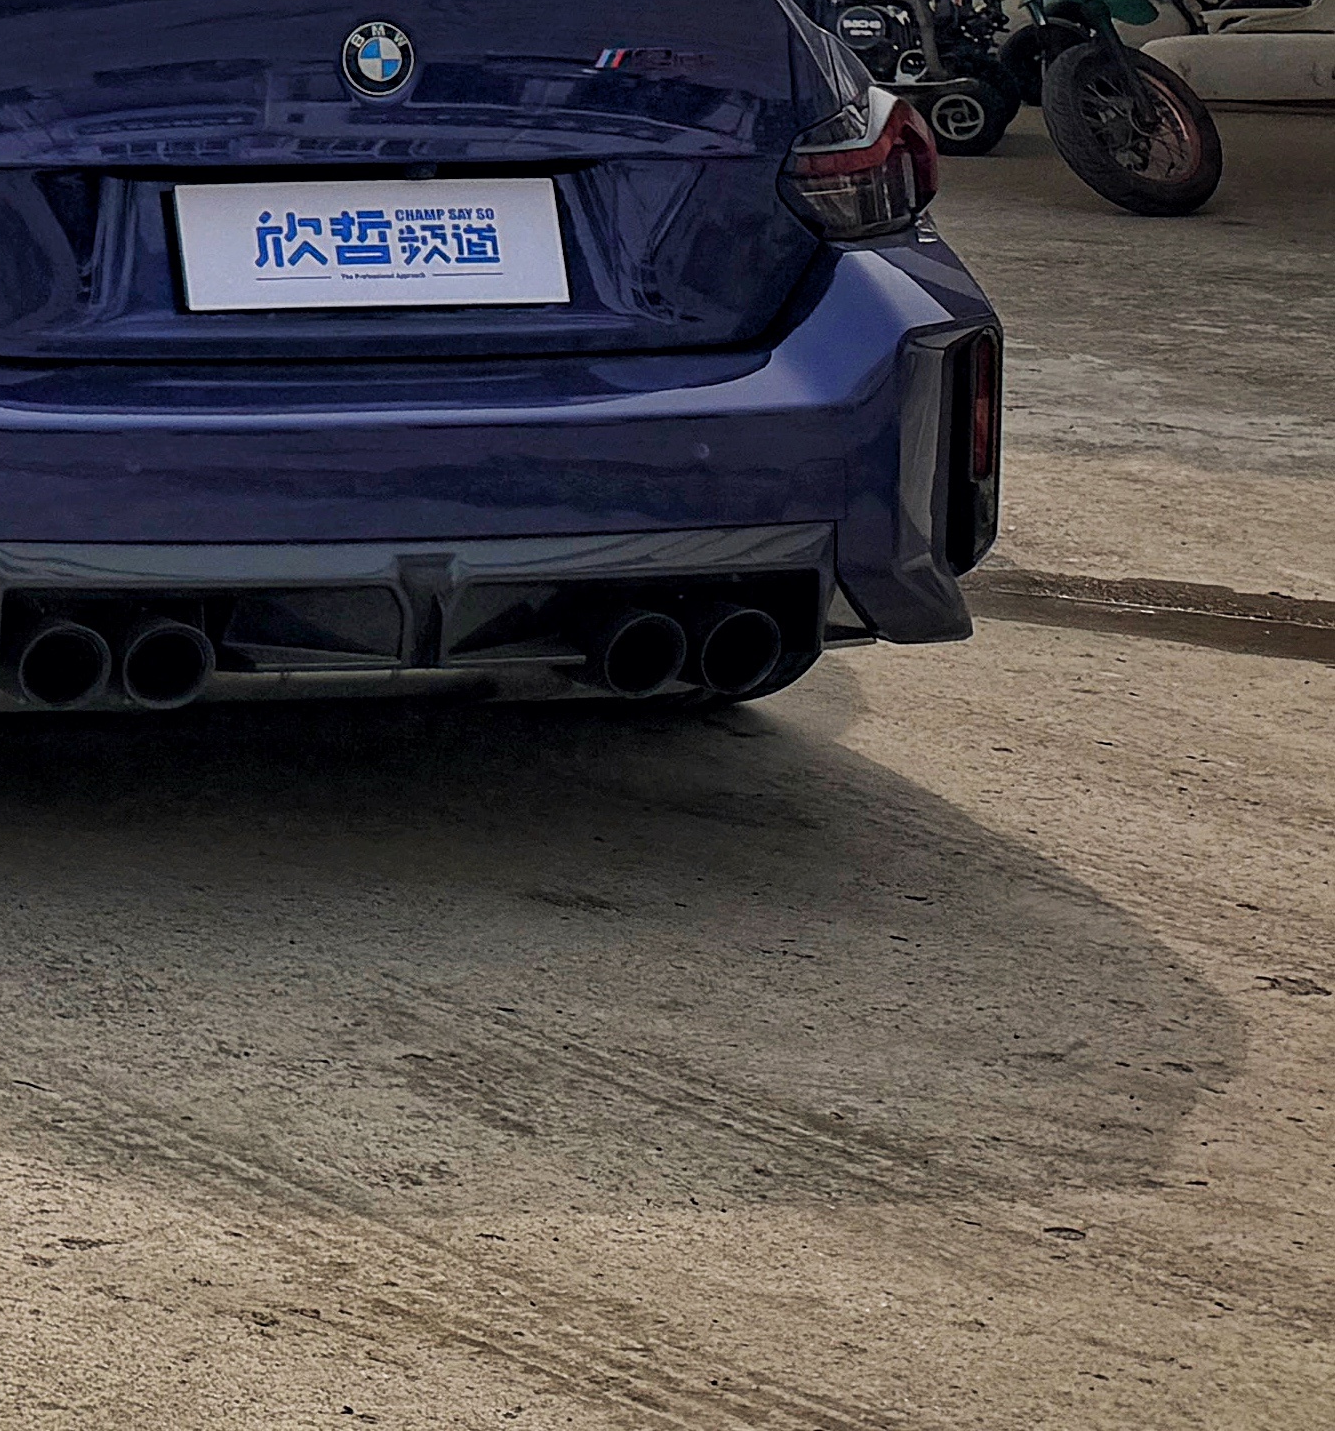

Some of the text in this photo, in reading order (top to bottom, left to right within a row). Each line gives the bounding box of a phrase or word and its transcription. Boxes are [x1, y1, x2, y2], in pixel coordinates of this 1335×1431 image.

[350, 24, 409, 48] BMW
[394, 207, 495, 222] CHAMP SAY SO
[255, 210, 501, 268] 欣哲频道
